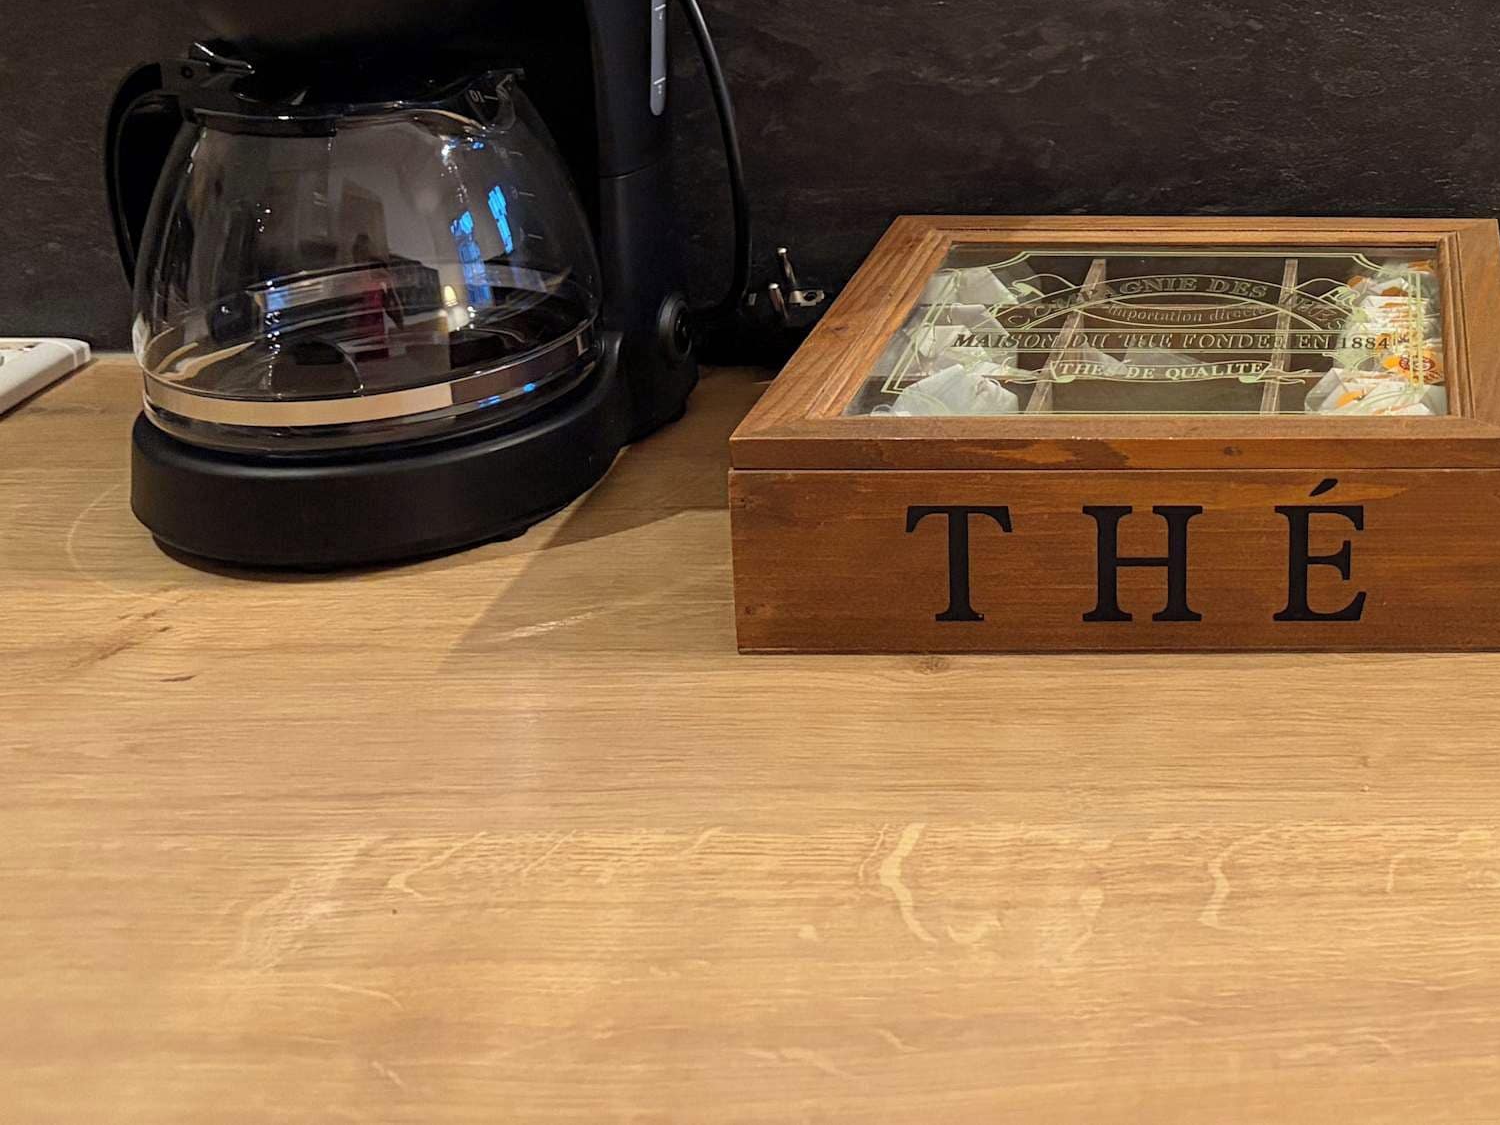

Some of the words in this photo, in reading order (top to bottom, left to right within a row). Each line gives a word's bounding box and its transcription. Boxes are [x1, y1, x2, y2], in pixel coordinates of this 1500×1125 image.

[1208, 277, 1269, 299] DES
[951, 332, 1061, 349] MAISON
[1296, 334, 1331, 350] EN
[1339, 336, 1391, 350] 1884
[1125, 366, 1156, 380] DE
[905, 478, 1368, 623] THÉ
